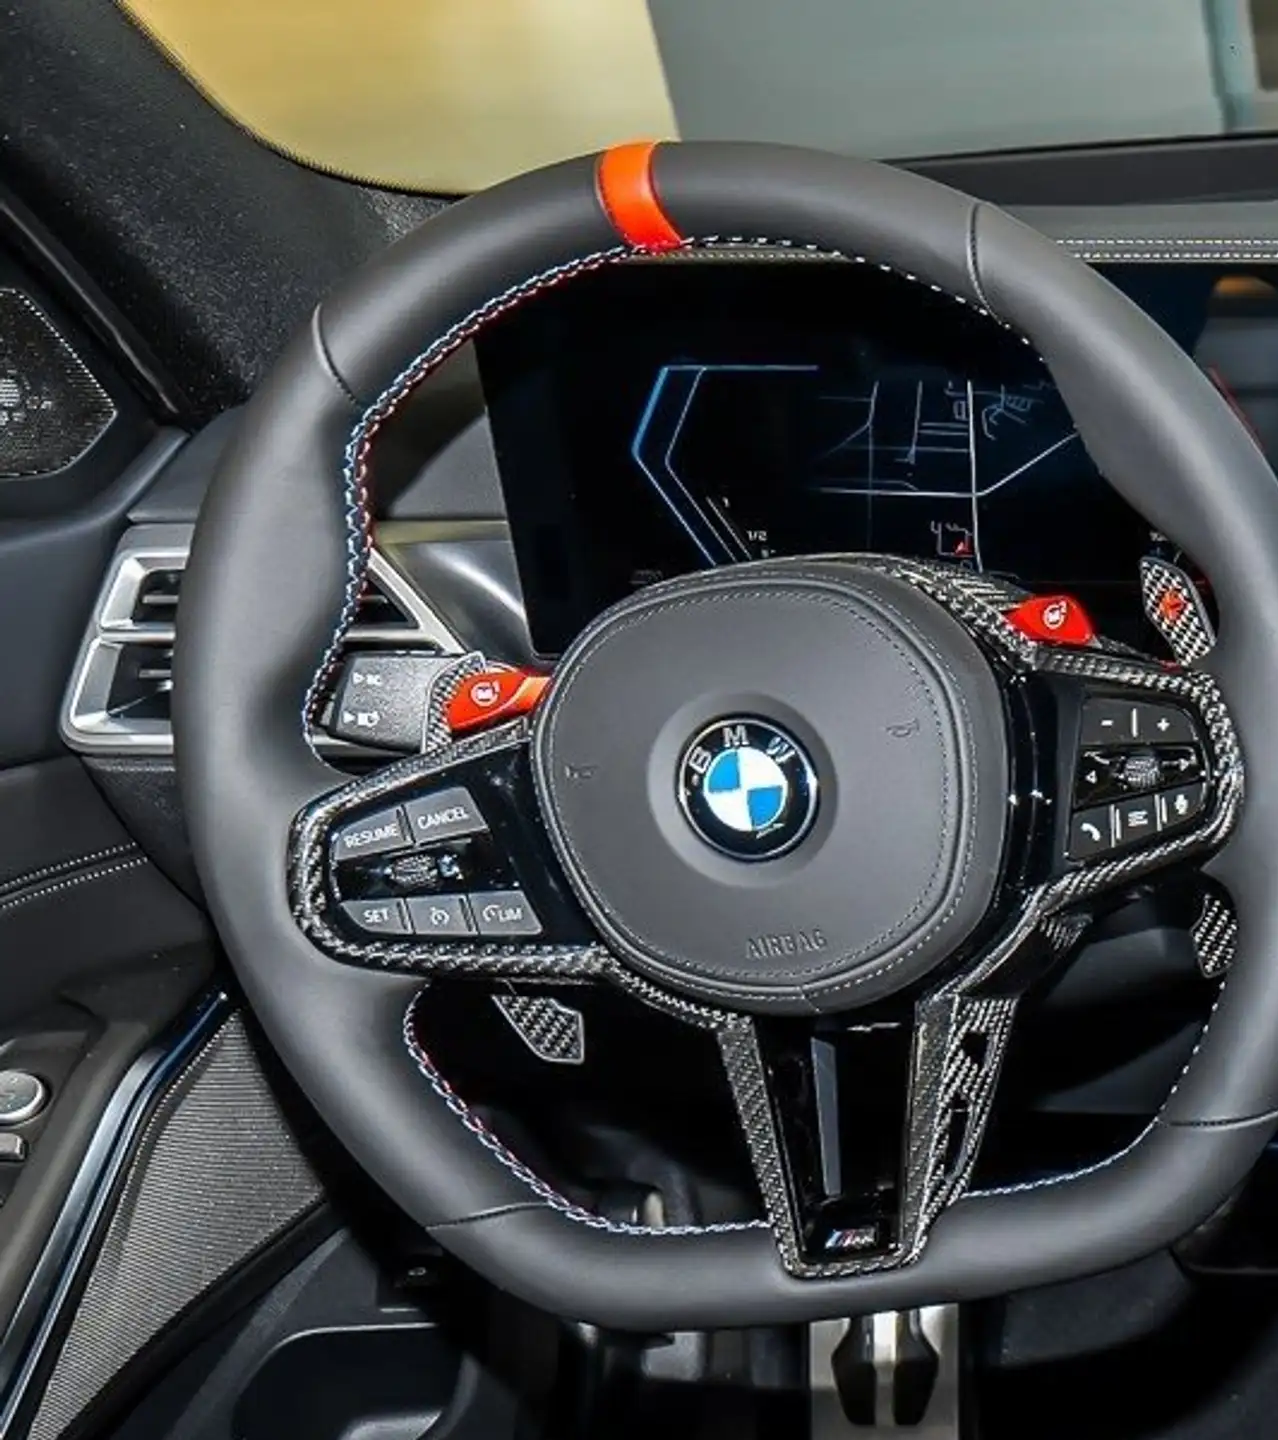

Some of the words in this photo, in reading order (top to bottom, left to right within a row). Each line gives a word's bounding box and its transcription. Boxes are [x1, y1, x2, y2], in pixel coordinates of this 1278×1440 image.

[746, 530, 768, 541] 1/2
[689, 724, 796, 774] BMW
[417, 807, 469, 830] CANCEL
[344, 824, 399, 848] RESUME
[363, 908, 390, 923] SET
[499, 908, 522, 921] LIM
[747, 929, 828, 960] AIRBAG
